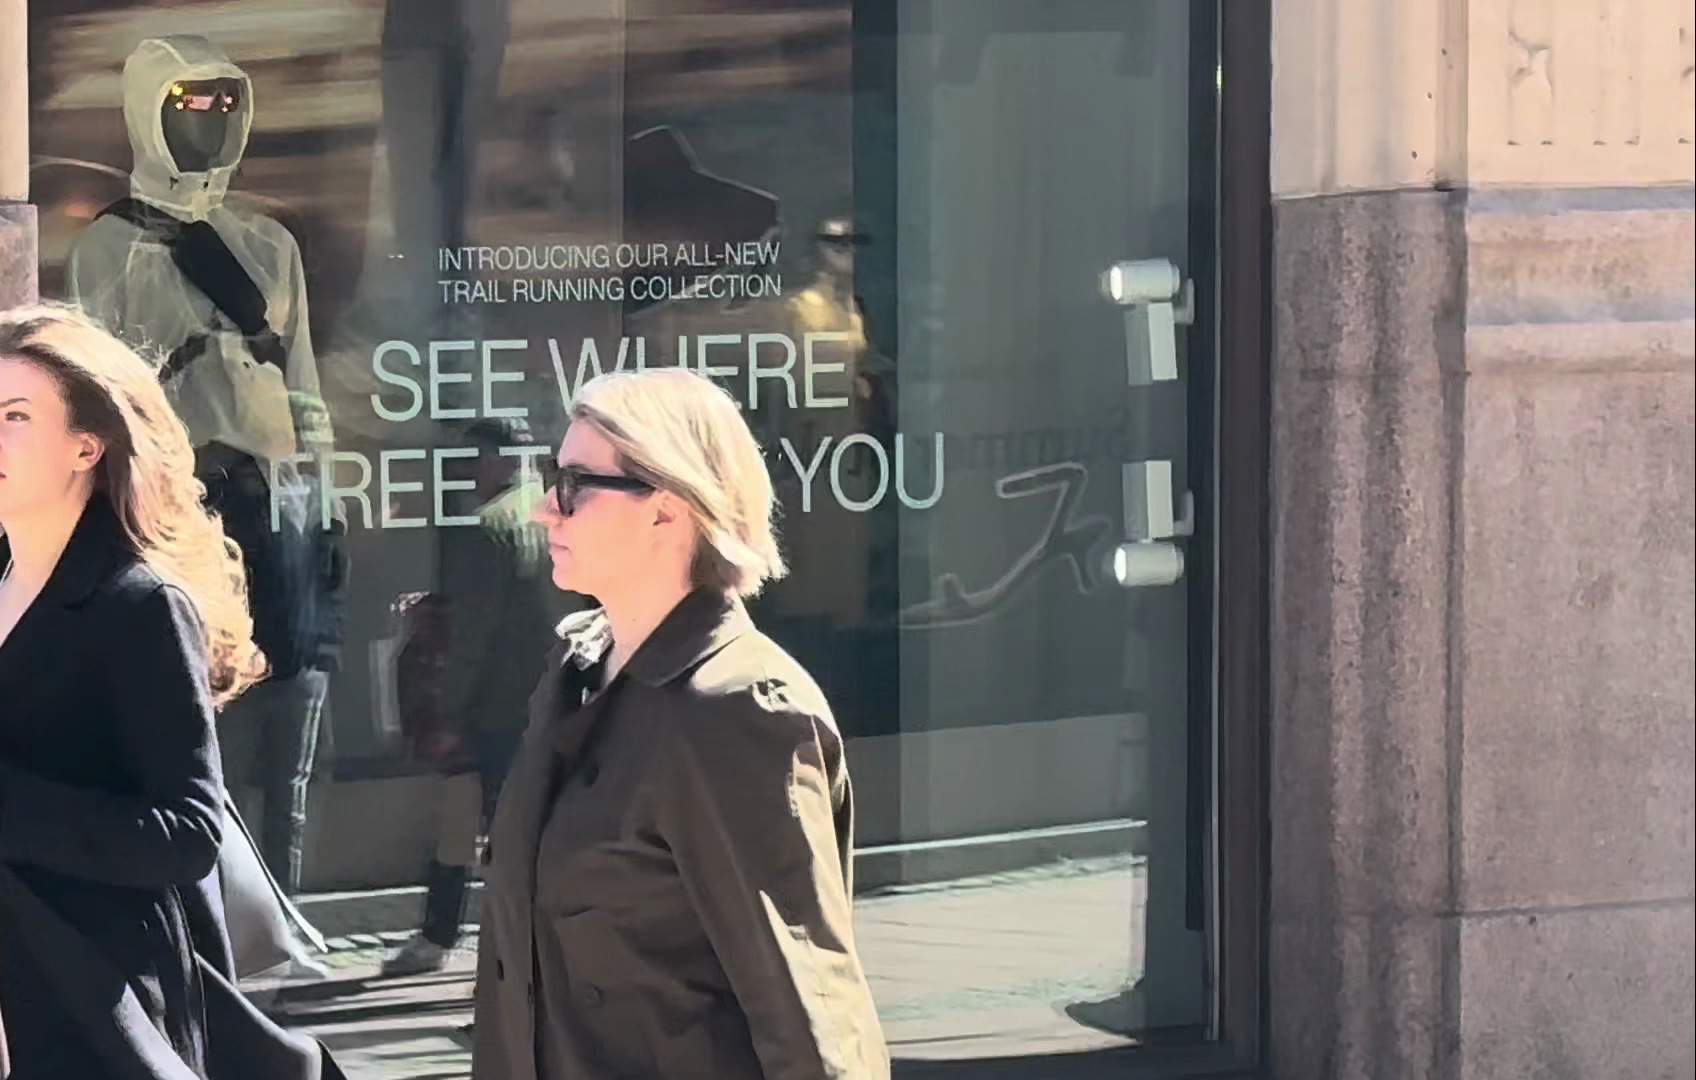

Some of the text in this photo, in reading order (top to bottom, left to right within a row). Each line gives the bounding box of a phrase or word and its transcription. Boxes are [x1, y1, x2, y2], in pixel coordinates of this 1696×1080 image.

[438, 241, 781, 272] INTRODUCING OUR ALL-NEW
[438, 274, 781, 304] TRAIL RUNNING COLLECTION
[370, 339, 529, 422] SEE
[270, 448, 481, 533] FREE
[780, 431, 945, 515] YOU
